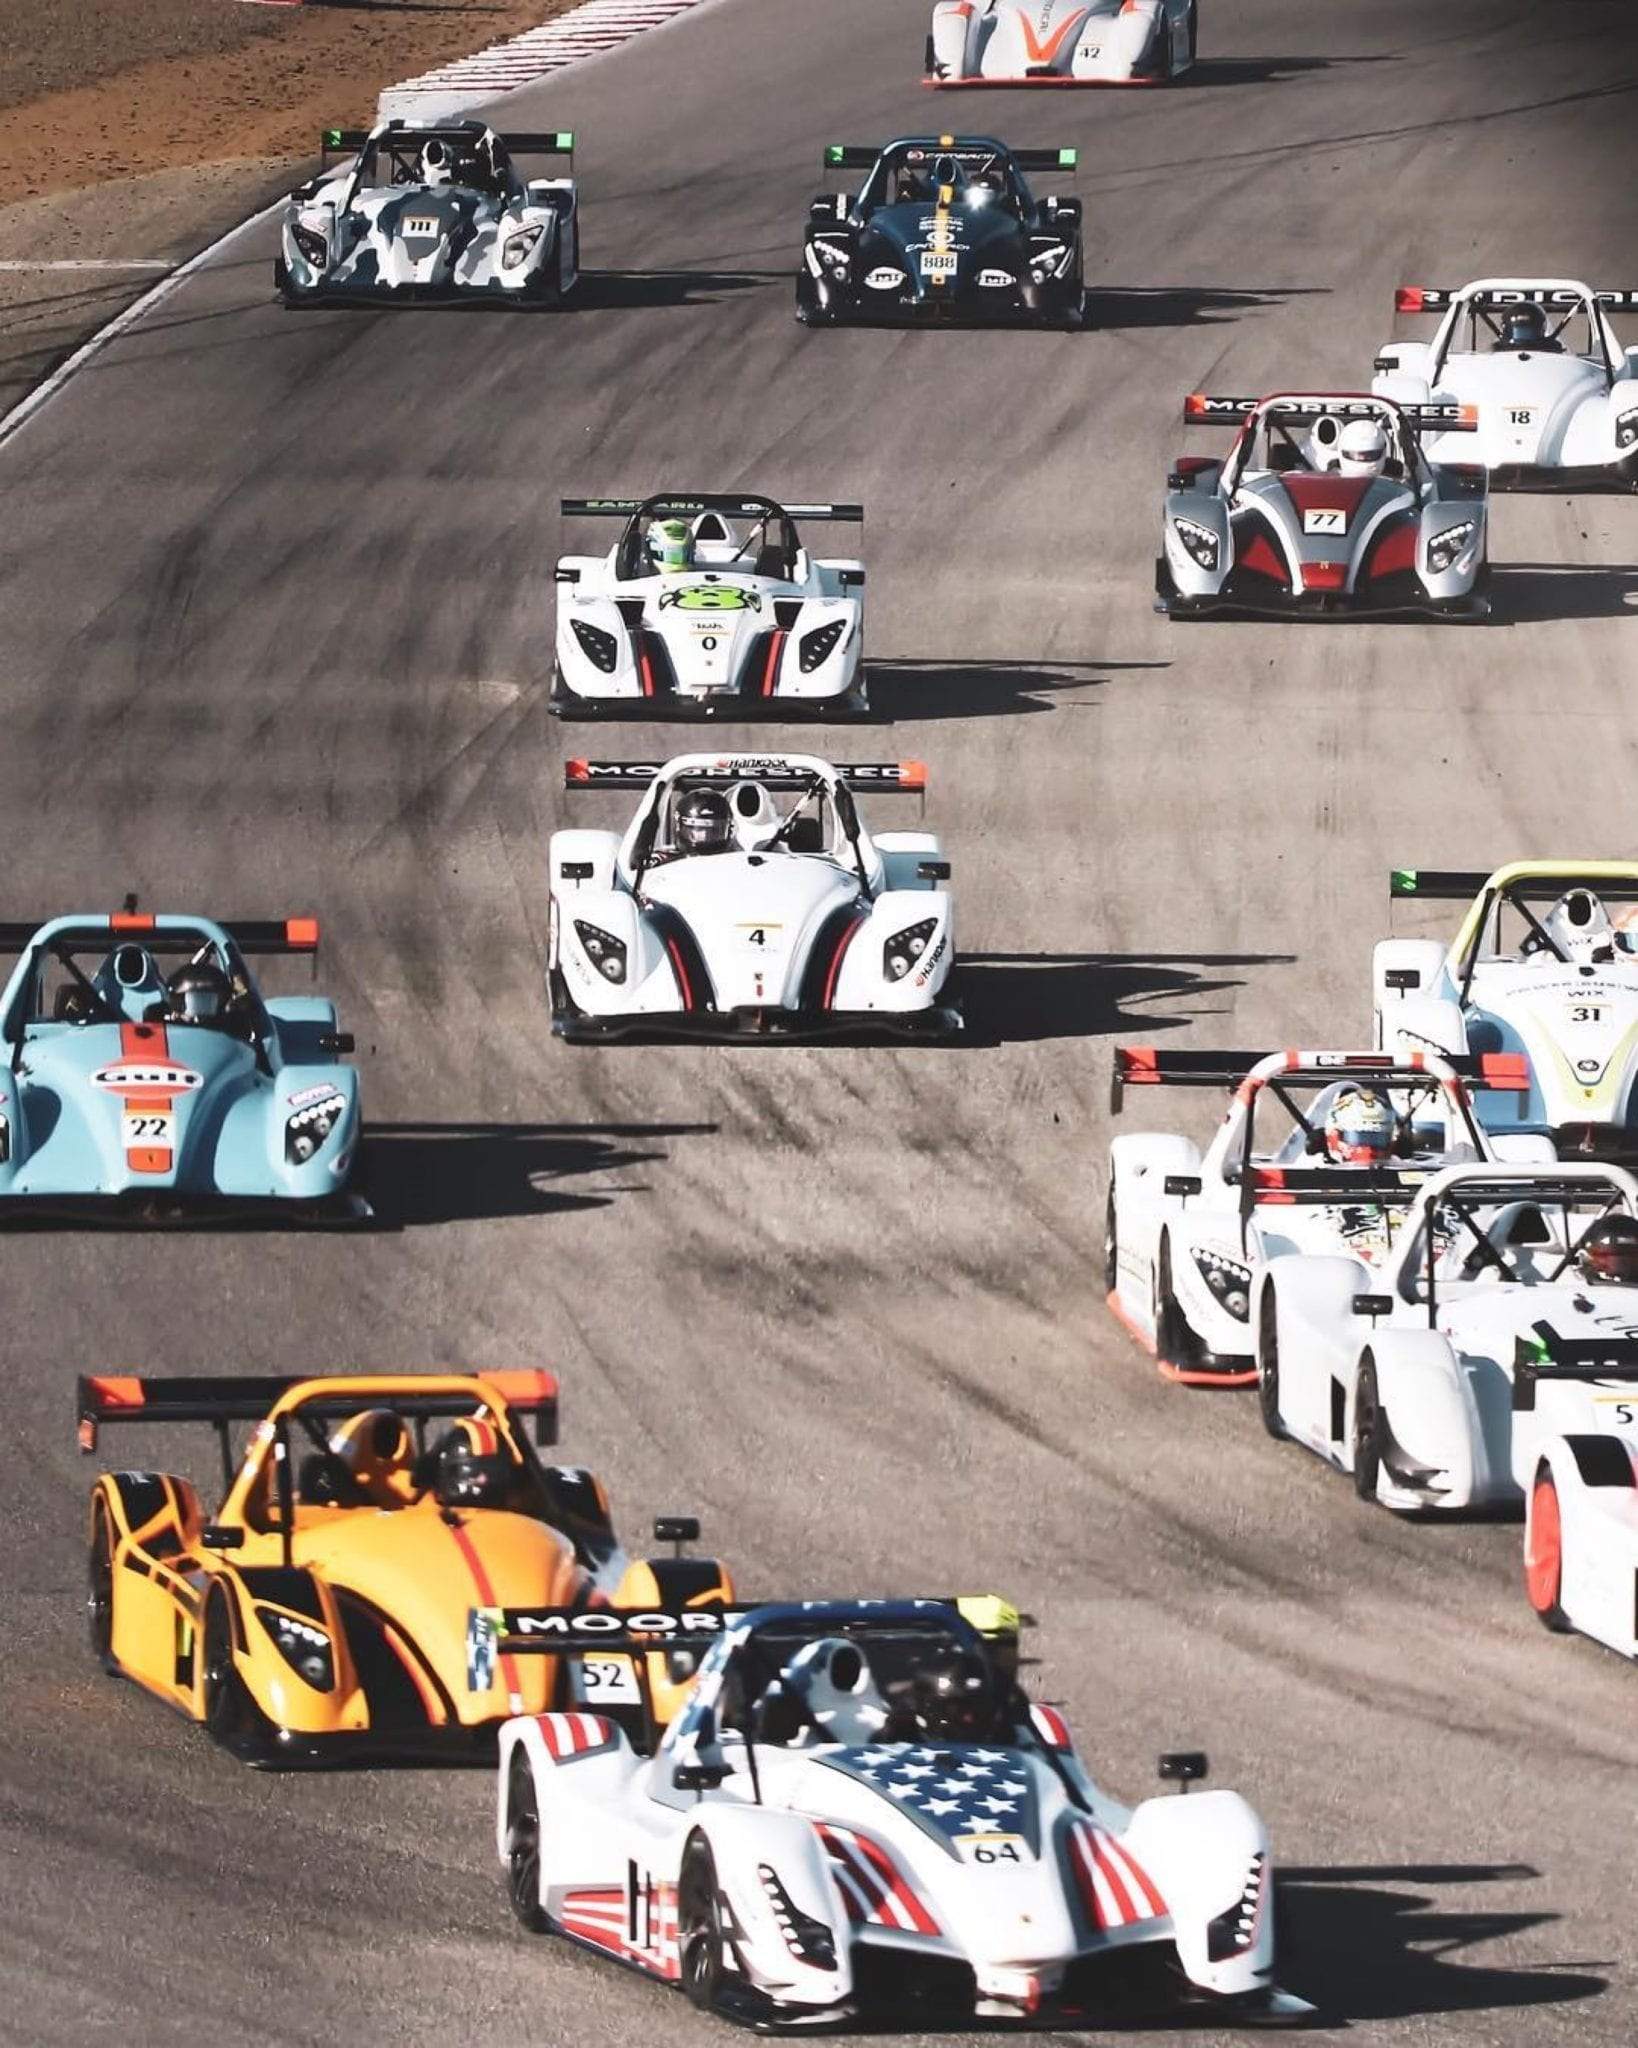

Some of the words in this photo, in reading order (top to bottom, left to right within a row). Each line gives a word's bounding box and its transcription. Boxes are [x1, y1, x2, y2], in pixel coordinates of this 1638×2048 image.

[1080, 46, 1100, 58] 42
[924, 257, 955, 269] 888
[1511, 411, 1530, 424] 18
[1312, 513, 1339, 526] 77
[702, 636, 717, 651] 0
[749, 929, 766, 946] 4
[1571, 1007, 1601, 1022] 31
[131, 1118, 168, 1137] 22
[1616, 1404, 1634, 1424] 5
[583, 1663, 624, 1688] 52
[975, 1842, 1020, 1864] 64
